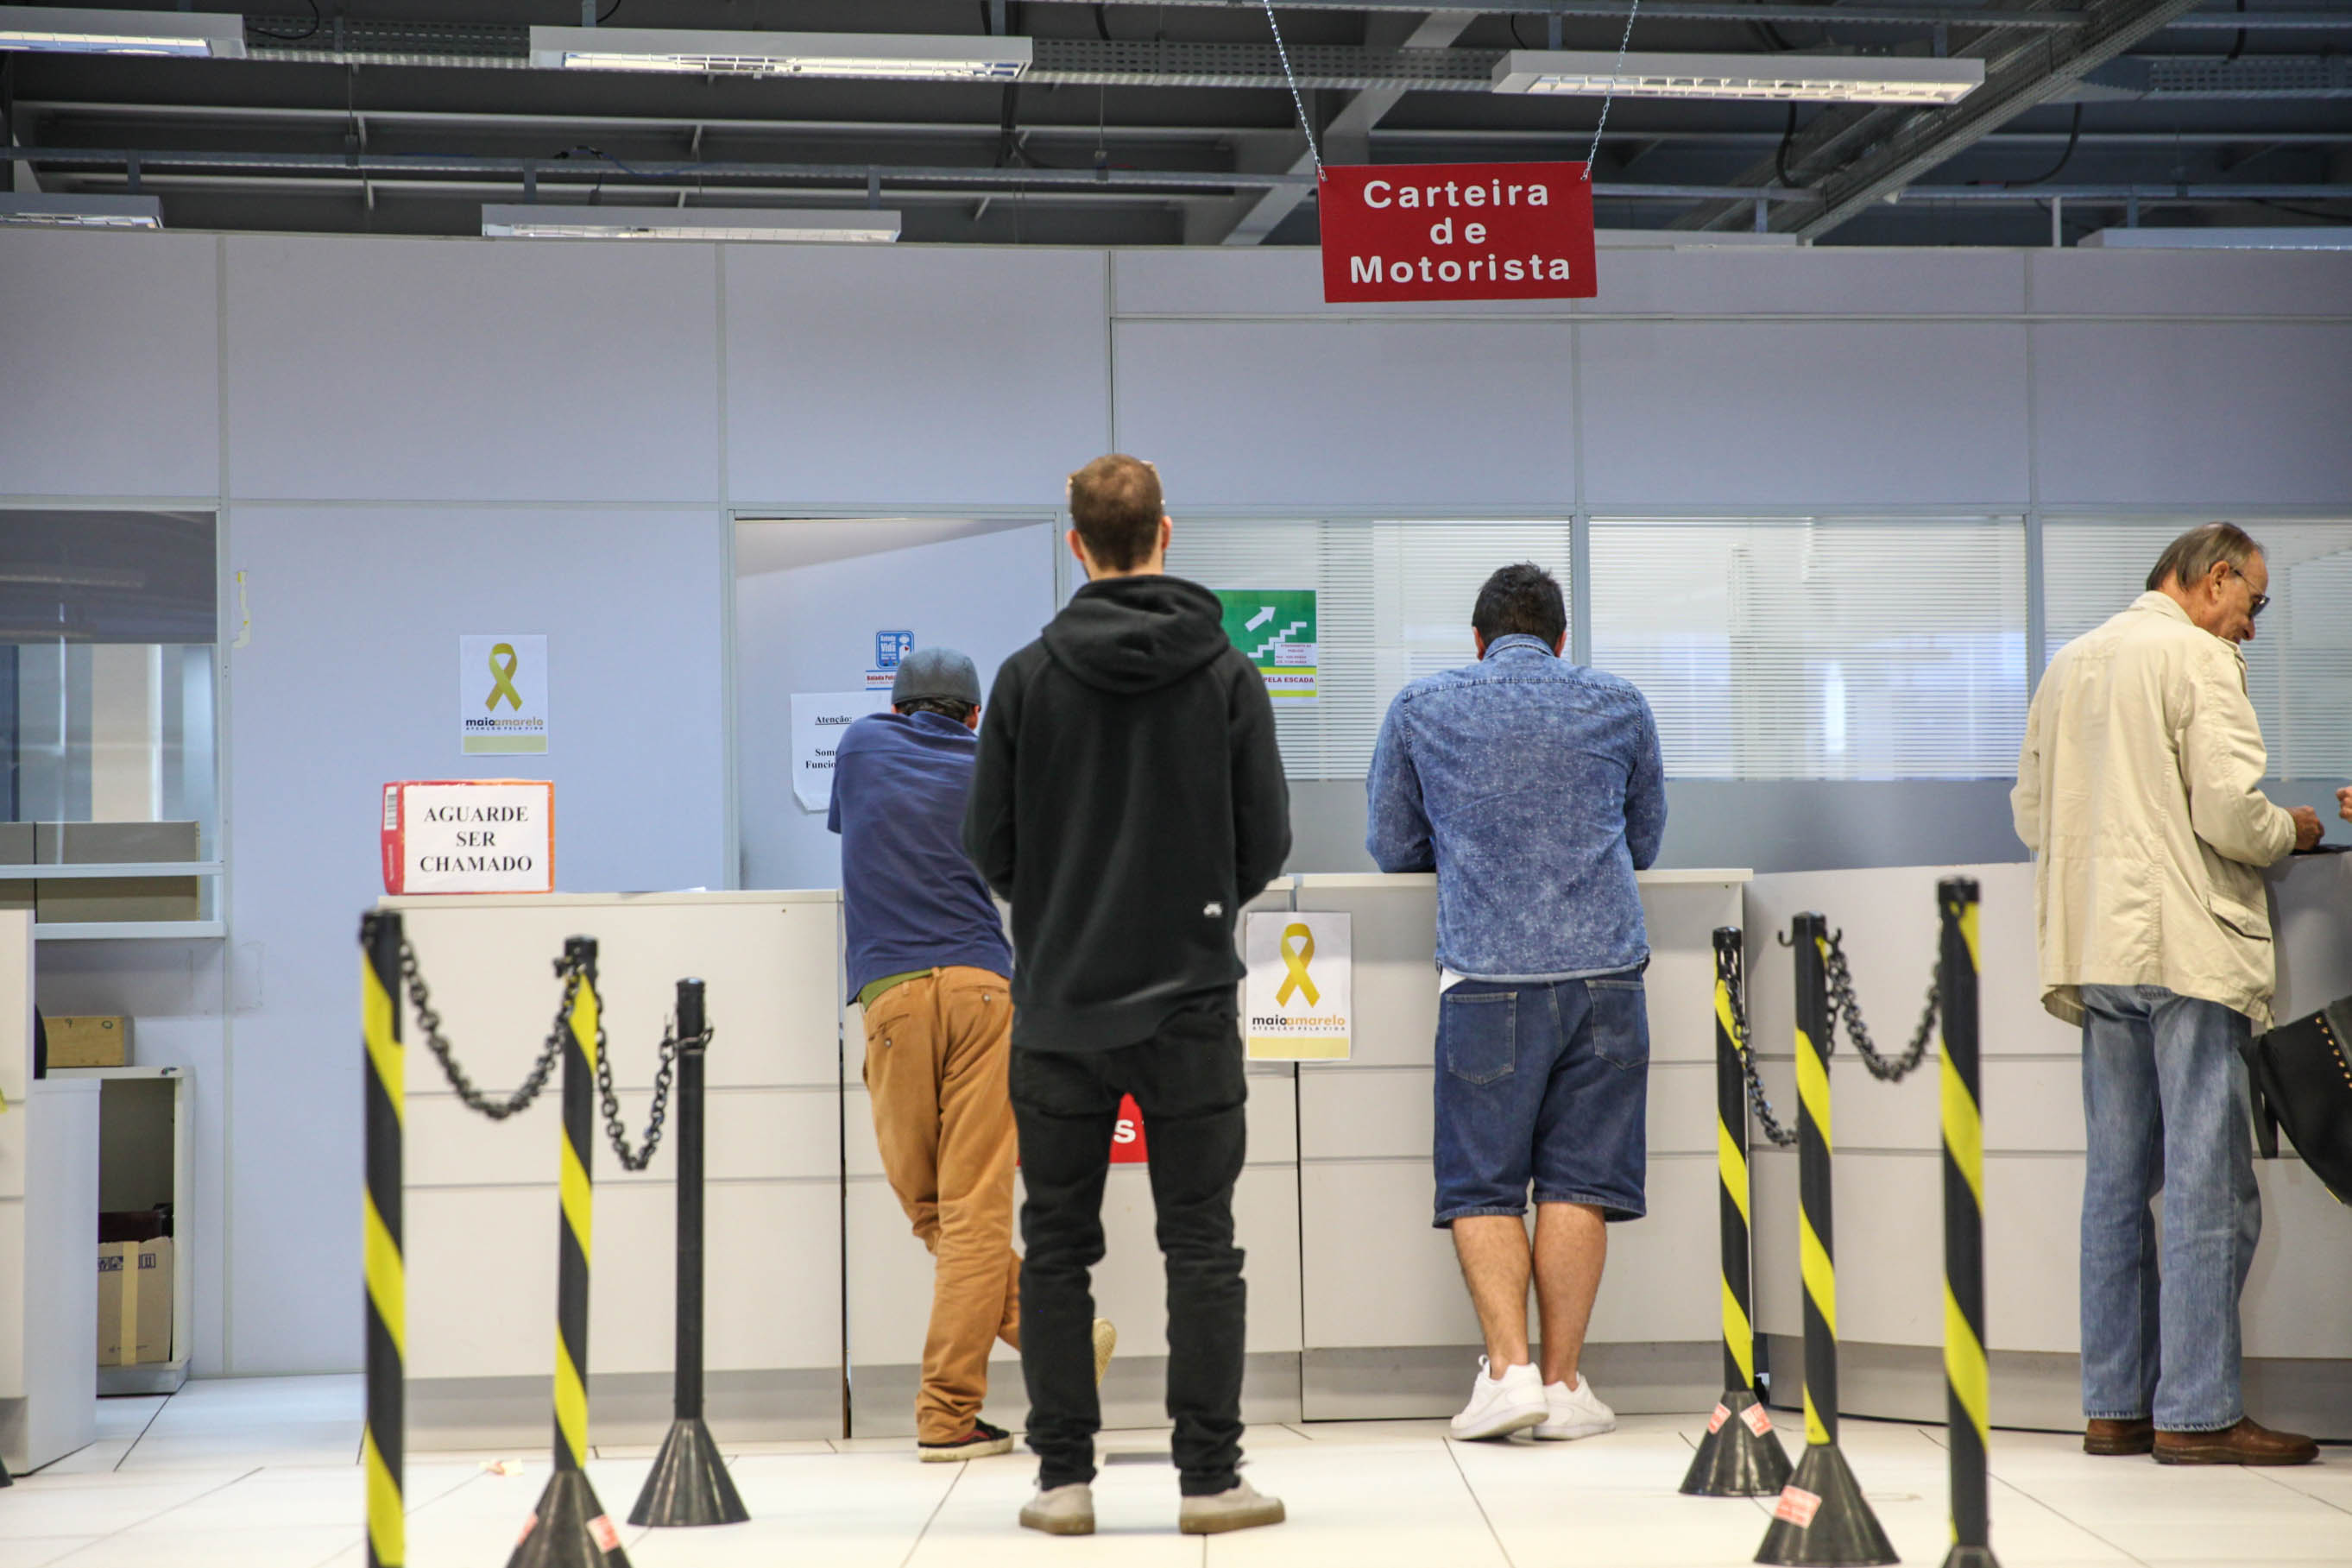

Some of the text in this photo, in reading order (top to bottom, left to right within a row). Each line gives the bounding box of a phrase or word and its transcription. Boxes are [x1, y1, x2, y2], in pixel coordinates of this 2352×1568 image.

[1363, 179, 1548, 209] Carteira
[1429, 217, 1487, 245] de
[1350, 254, 1570, 284] Motorista
[815, 715, 854, 725] Atenção:
[815, 748, 836, 757] Som
[805, 760, 836, 769] Funcio
[424, 806, 529, 822] AGUARDE
[456, 830, 496, 847] SER
[419, 855, 533, 872] CHAMADO
